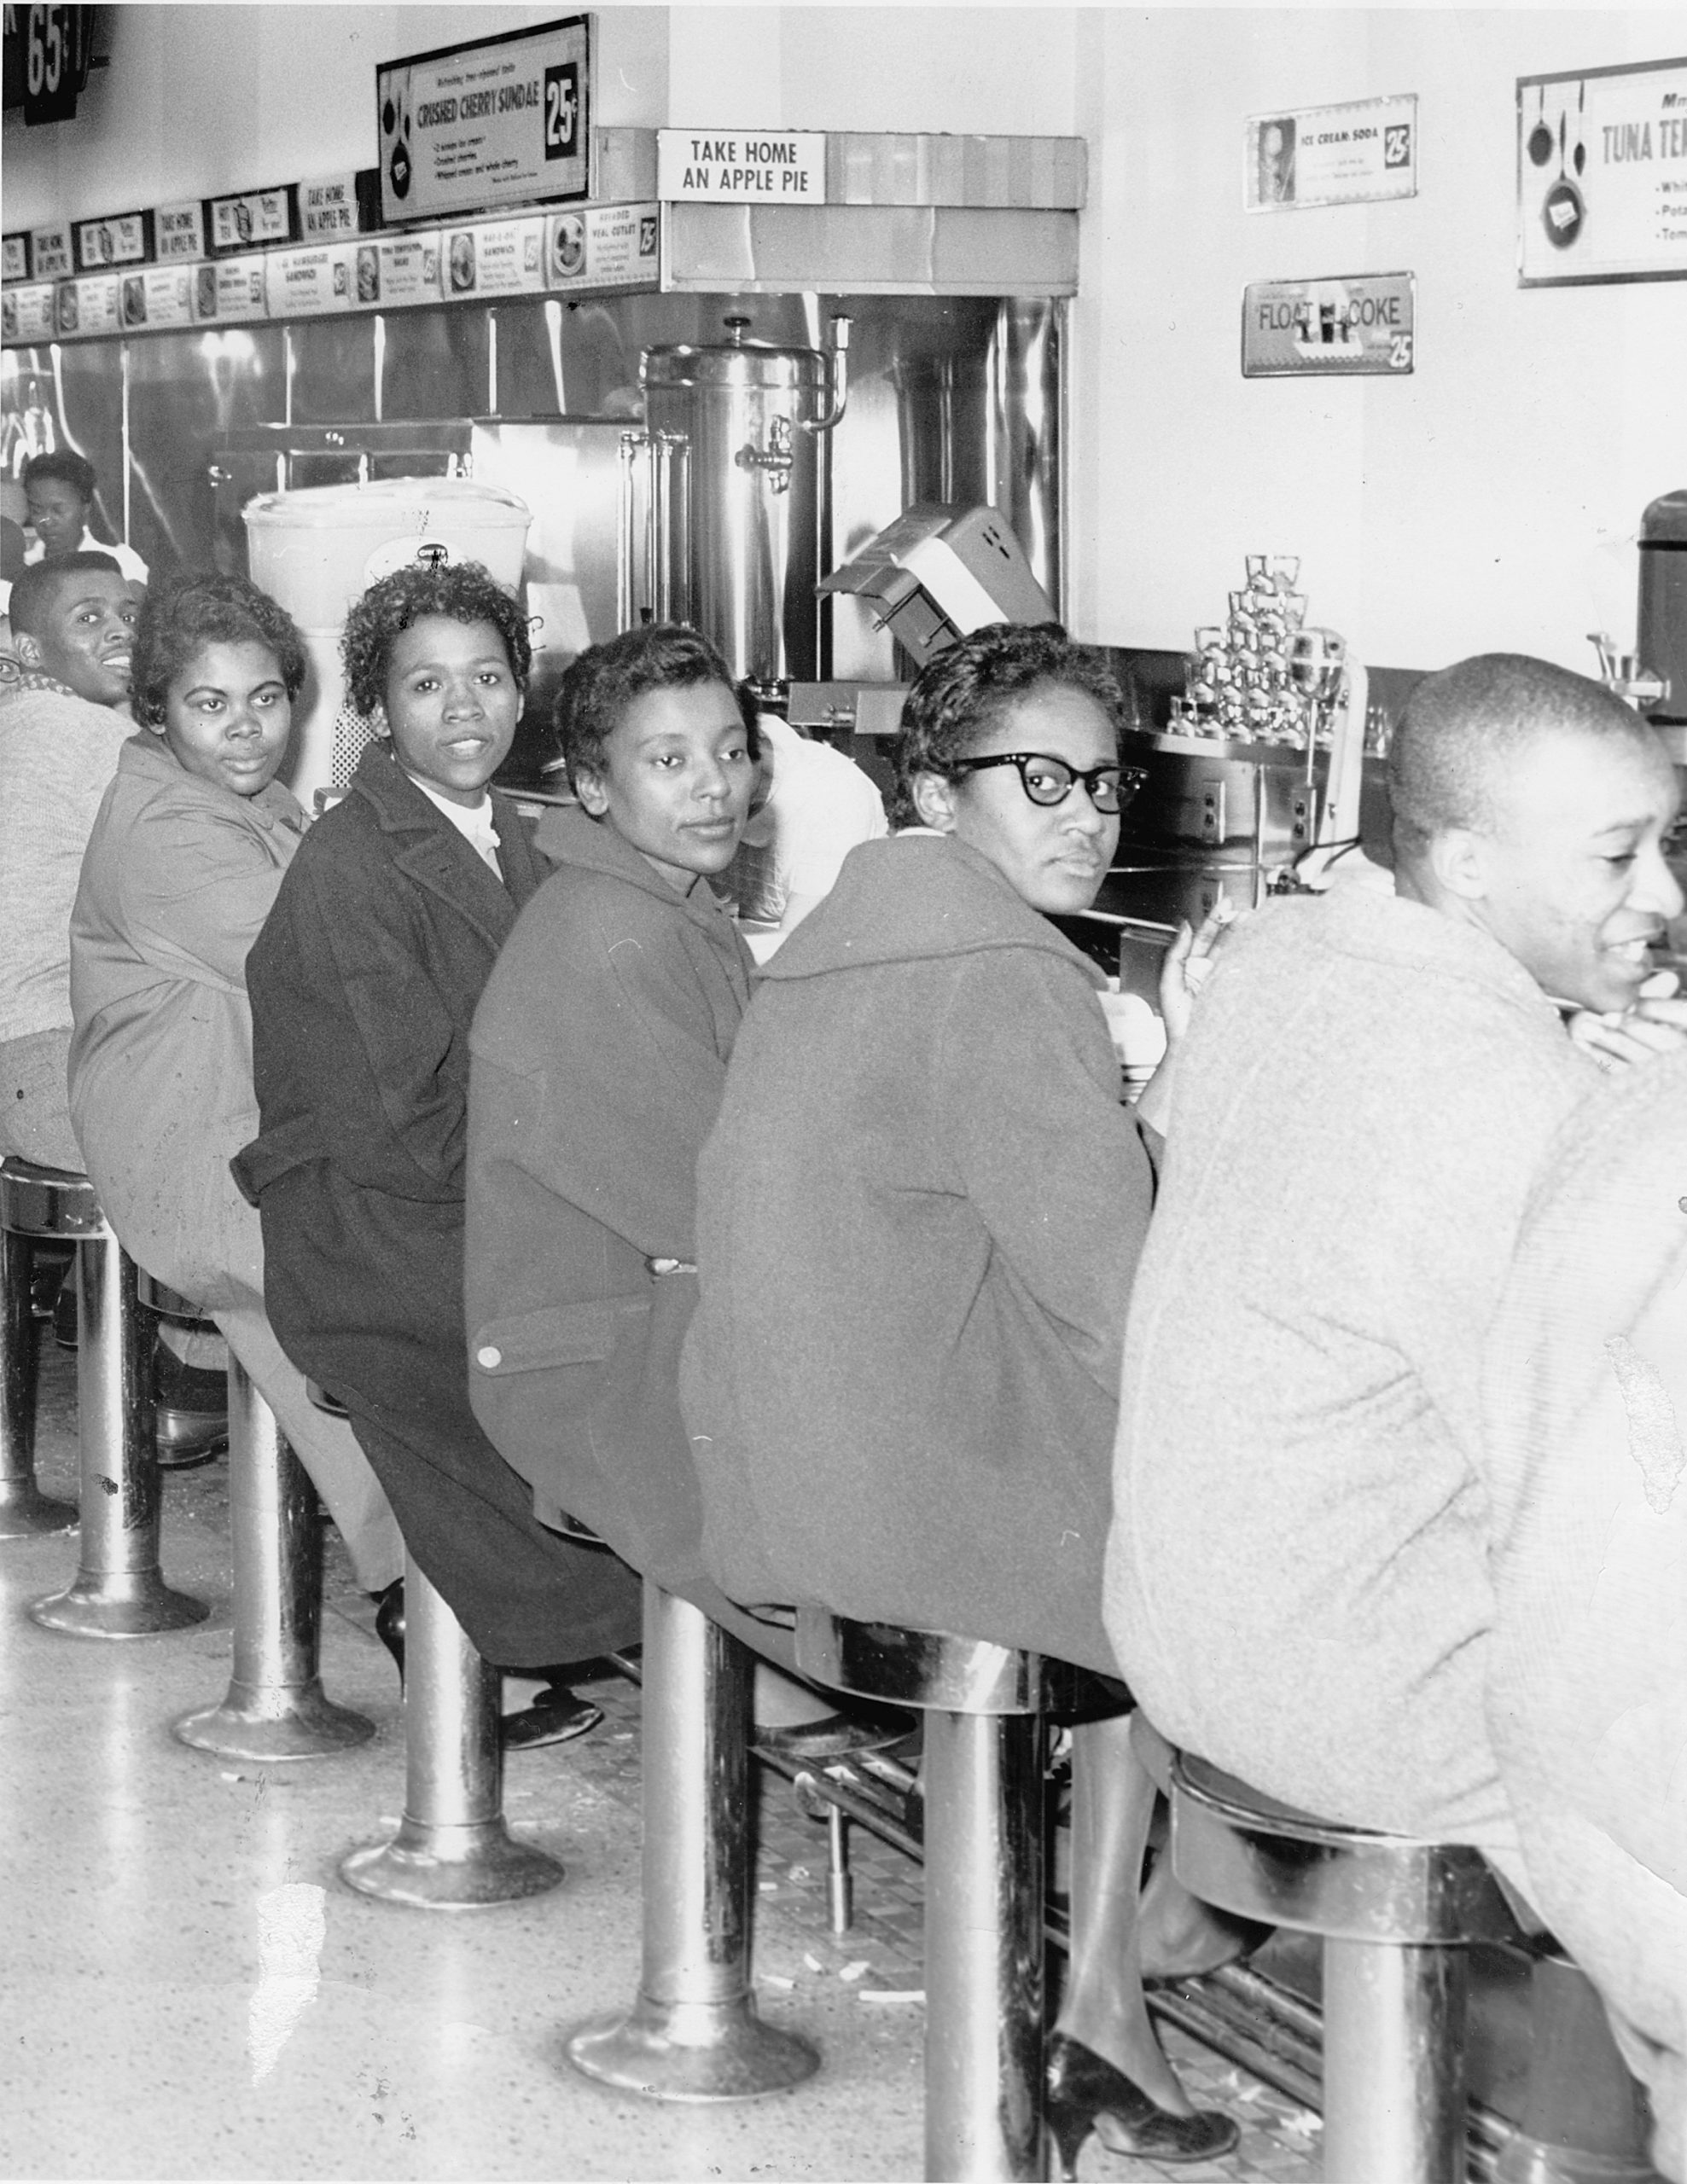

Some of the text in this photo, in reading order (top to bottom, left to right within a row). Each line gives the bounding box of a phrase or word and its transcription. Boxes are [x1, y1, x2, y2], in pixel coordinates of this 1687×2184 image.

[417, 81, 538, 128] CRUSHED CHERRY SUNDAE
[1318, 133, 1348, 145] CREAM
[1353, 128, 1378, 141] SODA
[1603, 122, 1652, 164] TUNA
[691, 140, 796, 164] TAKE HOME
[683, 167, 808, 192] AN APPLE PIE
[308, 184, 345, 206] TAKE HOME
[308, 208, 351, 230] AN APPLE PIE
[641, 222, 655, 253] 75
[1259, 296, 1401, 330] FLOAT COKE
[1389, 335, 1412, 368] 25
